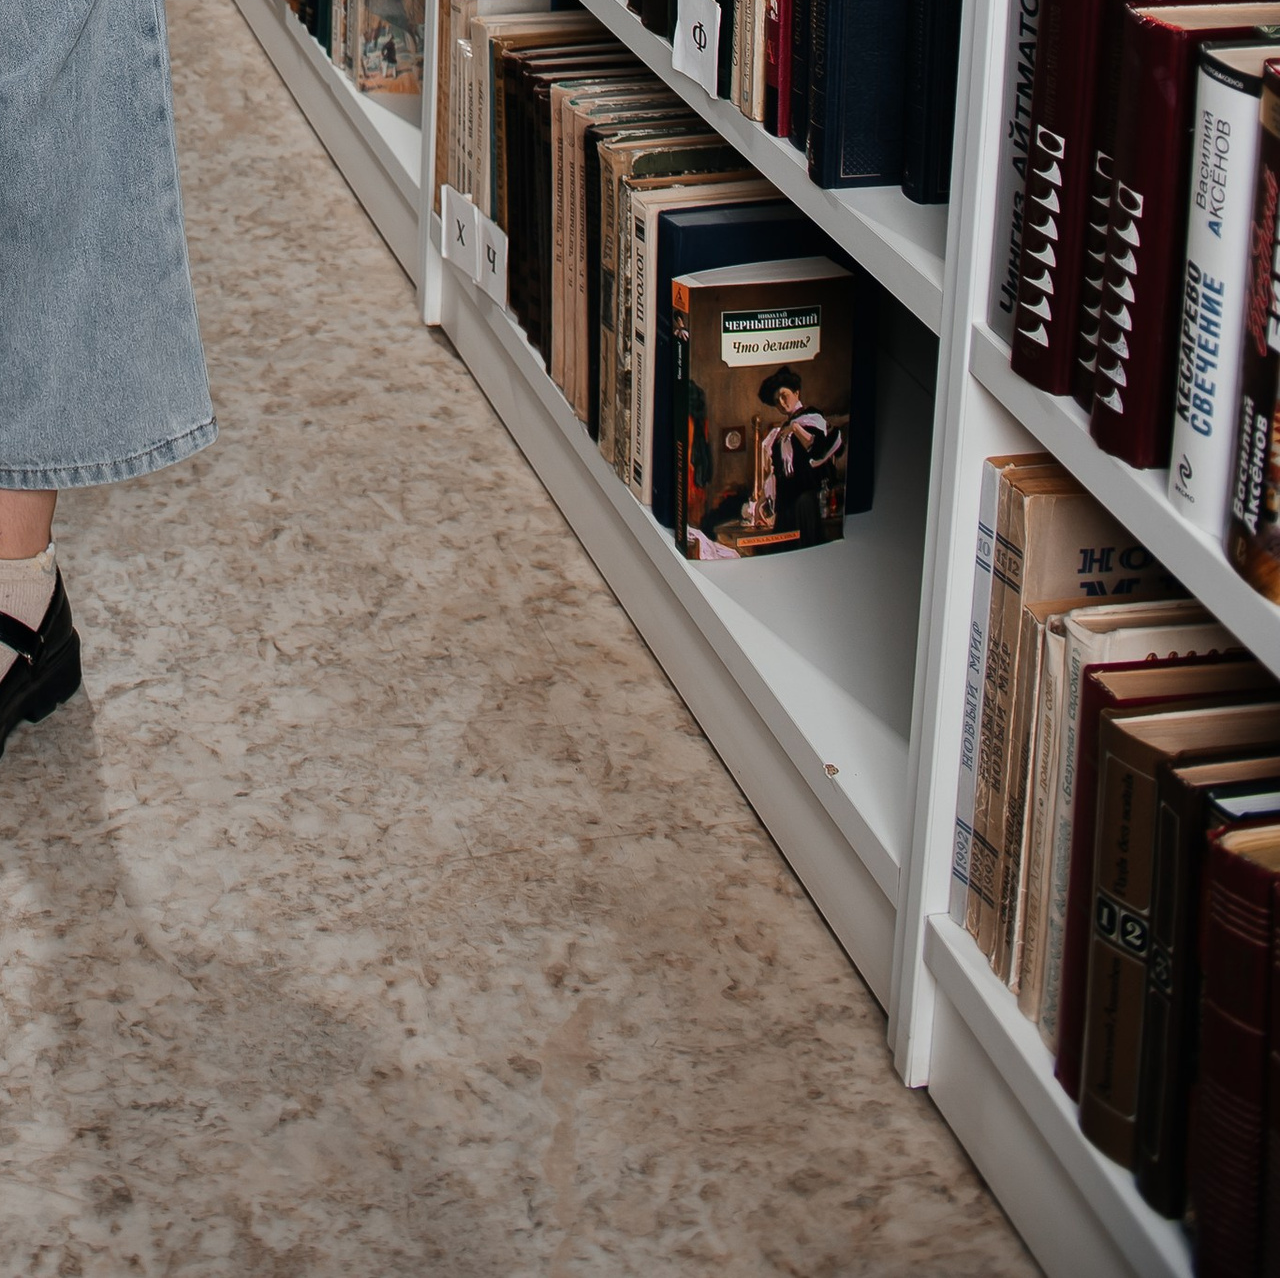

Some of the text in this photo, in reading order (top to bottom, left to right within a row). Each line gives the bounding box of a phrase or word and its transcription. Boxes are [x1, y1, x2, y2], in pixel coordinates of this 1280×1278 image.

[692, 21, 707, 50] Ф
[1194, 109, 1214, 210] Василий
[1207, 118, 1231, 240] АКСЁНОВ
[486, 244, 496, 274] Ч
[633, 246, 645, 322] ПРОЛОГ
[725, 314, 818, 331] ЧЕРНЫШЕВСКИЙ
[732, 336, 811, 354] Что делать?
[1176, 259, 1201, 423] КЕСАРЕВО
[1190, 272, 1225, 437] СВЕЧЕНИЕ
[1232, 395, 1255, 520] Василий
[1242, 415, 1269, 535] Аксёнов
[978, 540, 991, 556] 10
[961, 621, 983, 771] НОВЫЙ МИР
[954, 830, 969, 872] 1992
[1125, 921, 1144, 946] 2
